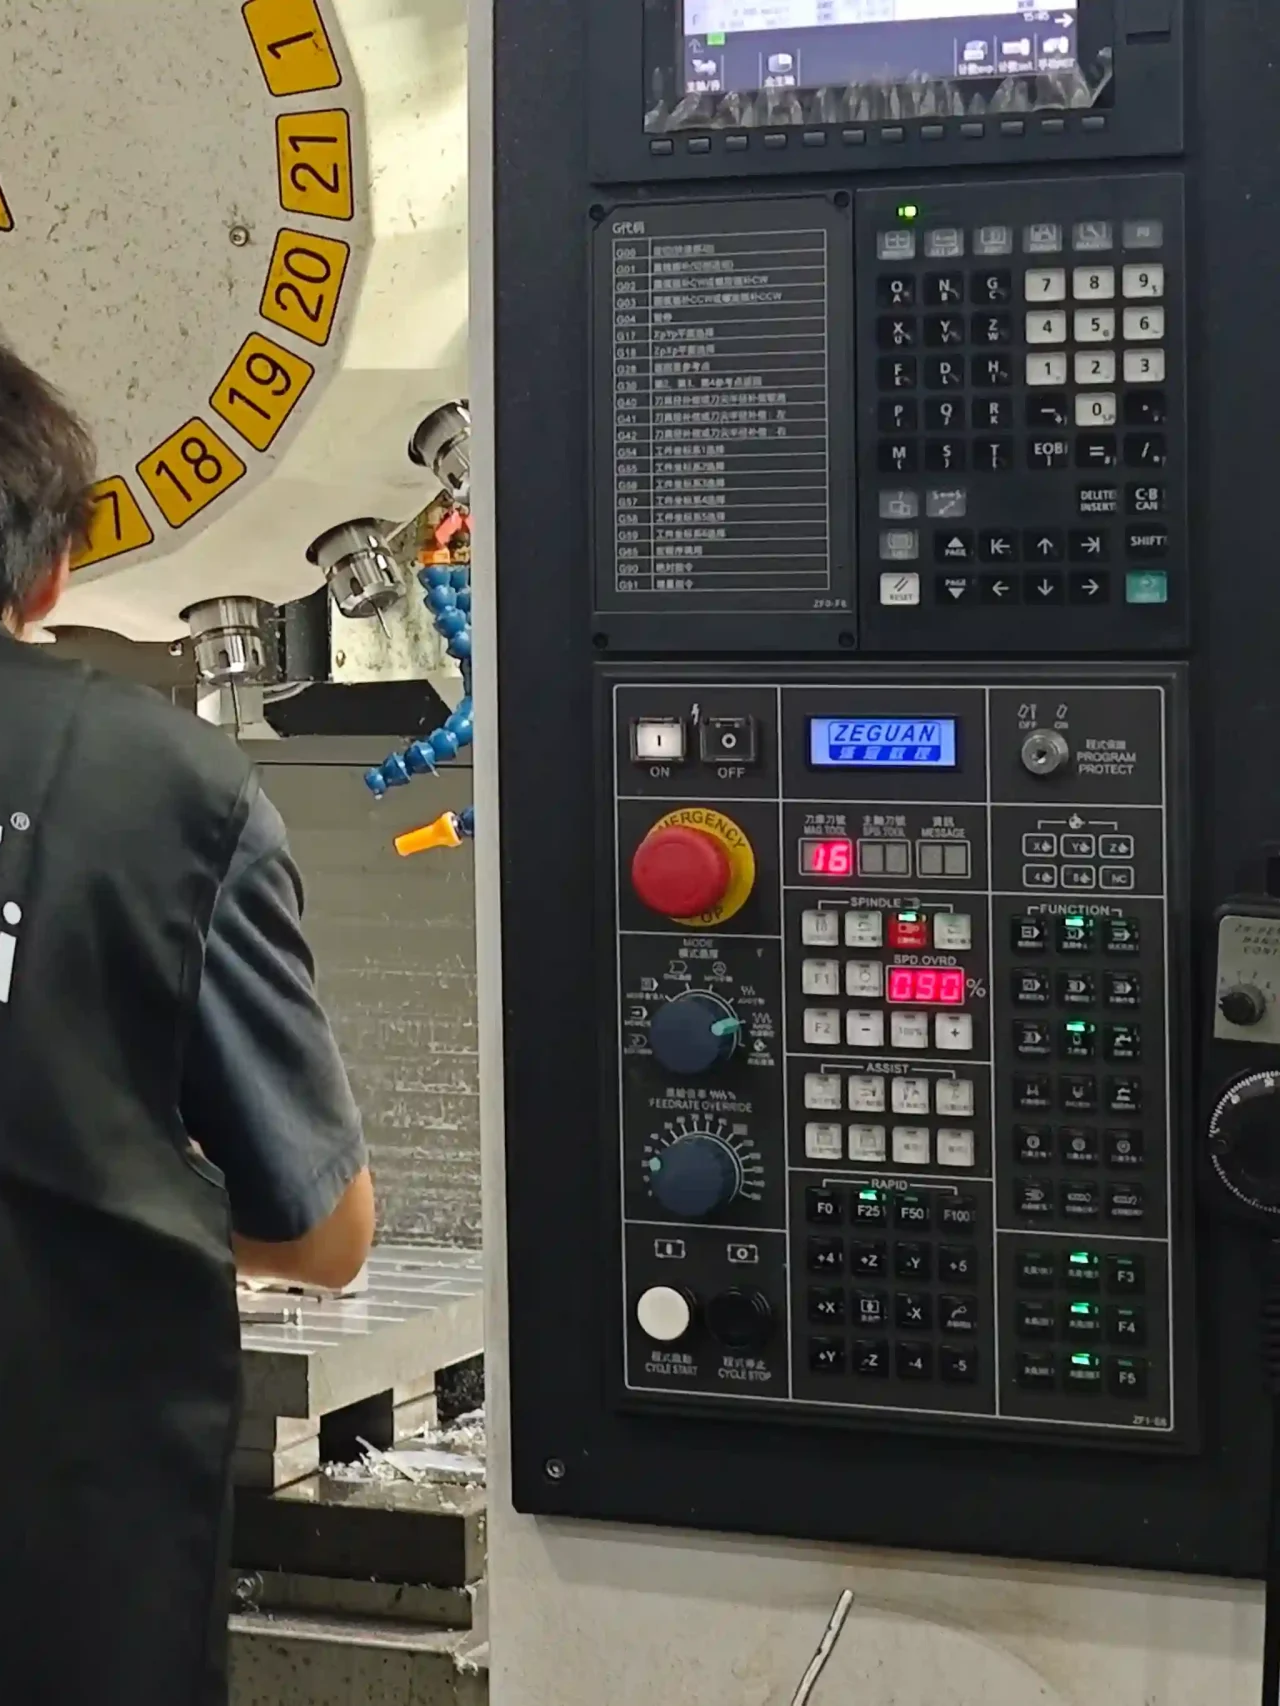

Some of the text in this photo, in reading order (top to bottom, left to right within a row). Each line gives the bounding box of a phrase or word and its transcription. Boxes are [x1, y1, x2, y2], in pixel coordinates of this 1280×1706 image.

[267, 29, 317, 60] 1
[289, 134, 340, 195] 21
[275, 246, 332, 324] 20
[939, 280, 950, 291] N
[987, 278, 998, 289] G
[1042, 278, 1051, 292] 7
[1090, 276, 1099, 289] 8
[1139, 273, 1149, 287] 9
[891, 281, 903, 293] O
[893, 322, 904, 333] X
[940, 320, 951, 332] Y
[989, 319, 998, 330] Z
[1042, 320, 1052, 334] 4
[1091, 318, 1100, 332] 5
[1140, 316, 1149, 330] 6
[894, 363, 902, 375] F
[940, 362, 951, 374] D
[988, 361, 999, 373] H
[1044, 362, 1051, 375] 1
[1091, 361, 1100, 374] 2
[1140, 359, 1149, 372] 3
[228, 352, 293, 421] 19
[895, 405, 903, 417] P
[940, 403, 952, 416] Q
[990, 402, 999, 414] R
[1092, 402, 1102, 417] 0
[892, 447, 906, 459] M
[943, 445, 951, 457] S
[990, 444, 1000, 456] T
[1034, 442, 1063, 455] EOB
[155, 437, 223, 502] 18
[1081, 490, 1115, 500] DELETE
[1081, 502, 1116, 512] INSERT
[1136, 502, 1157, 511] CAN
[1130, 535, 1162, 547] SHIFT
[834, 724, 936, 743] ZEGUAN
[1076, 751, 1136, 762] PROGRAM
[649, 766, 670, 777] ON
[717, 767, 746, 779] OFF
[1078, 763, 1133, 775] PROTECT
[921, 828, 965, 838] MESSAGE
[813, 842, 848, 872] 16
[850, 897, 901, 909] SPINDLE
[1040, 904, 1110, 916] FUNCTION
[683, 938, 713, 948] MODE
[965, 978, 986, 998] %
[815, 1022, 831, 1033] F2
[866, 1063, 909, 1074] ASSIST
[648, 1098, 753, 1113] FEEDRATE OVERRIDE
[871, 1179, 908, 1190] RAPID
[817, 1202, 833, 1214] F0
[857, 1205, 880, 1217] F25
[901, 1207, 924, 1219] F50
[944, 1210, 970, 1222] F100
[1117, 1271, 1135, 1283] F3
[1118, 1321, 1136, 1333] F4
[645, 1362, 698, 1376] CYCLE START
[718, 1368, 772, 1382] CYCLE STOP
[1119, 1372, 1136, 1384] F5
